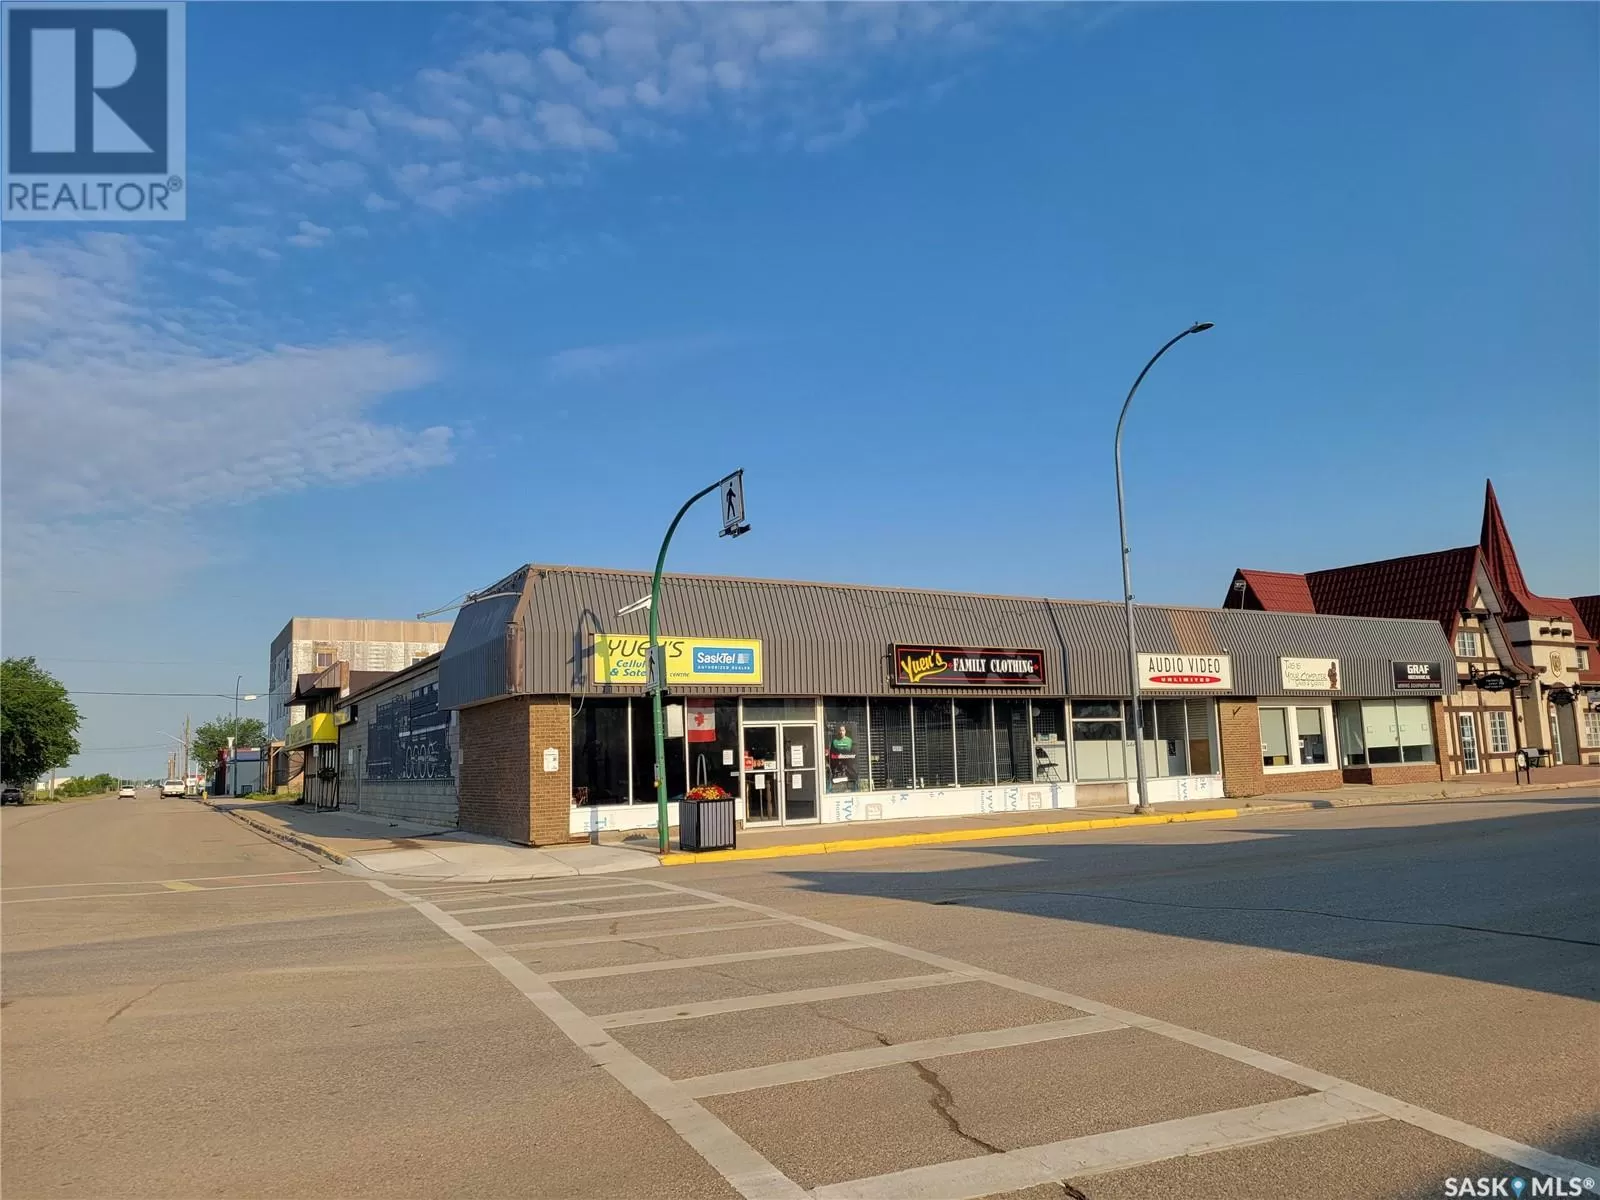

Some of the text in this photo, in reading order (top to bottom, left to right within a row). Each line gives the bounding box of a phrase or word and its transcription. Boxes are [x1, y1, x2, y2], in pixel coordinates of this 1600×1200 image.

[608, 639, 685, 658] YUE'S
[616, 659, 646, 668] Cellul
[697, 651, 736, 664] SaskTel
[953, 657, 1034, 673] FAMILY CLOTHING
[1148, 657, 1220, 673] AUDIO VIDEO
[609, 668, 618, 676] &
[901, 649, 948, 683] Yuen's
[1407, 664, 1429, 674] GRAF
[842, 796, 853, 821] Tyv
